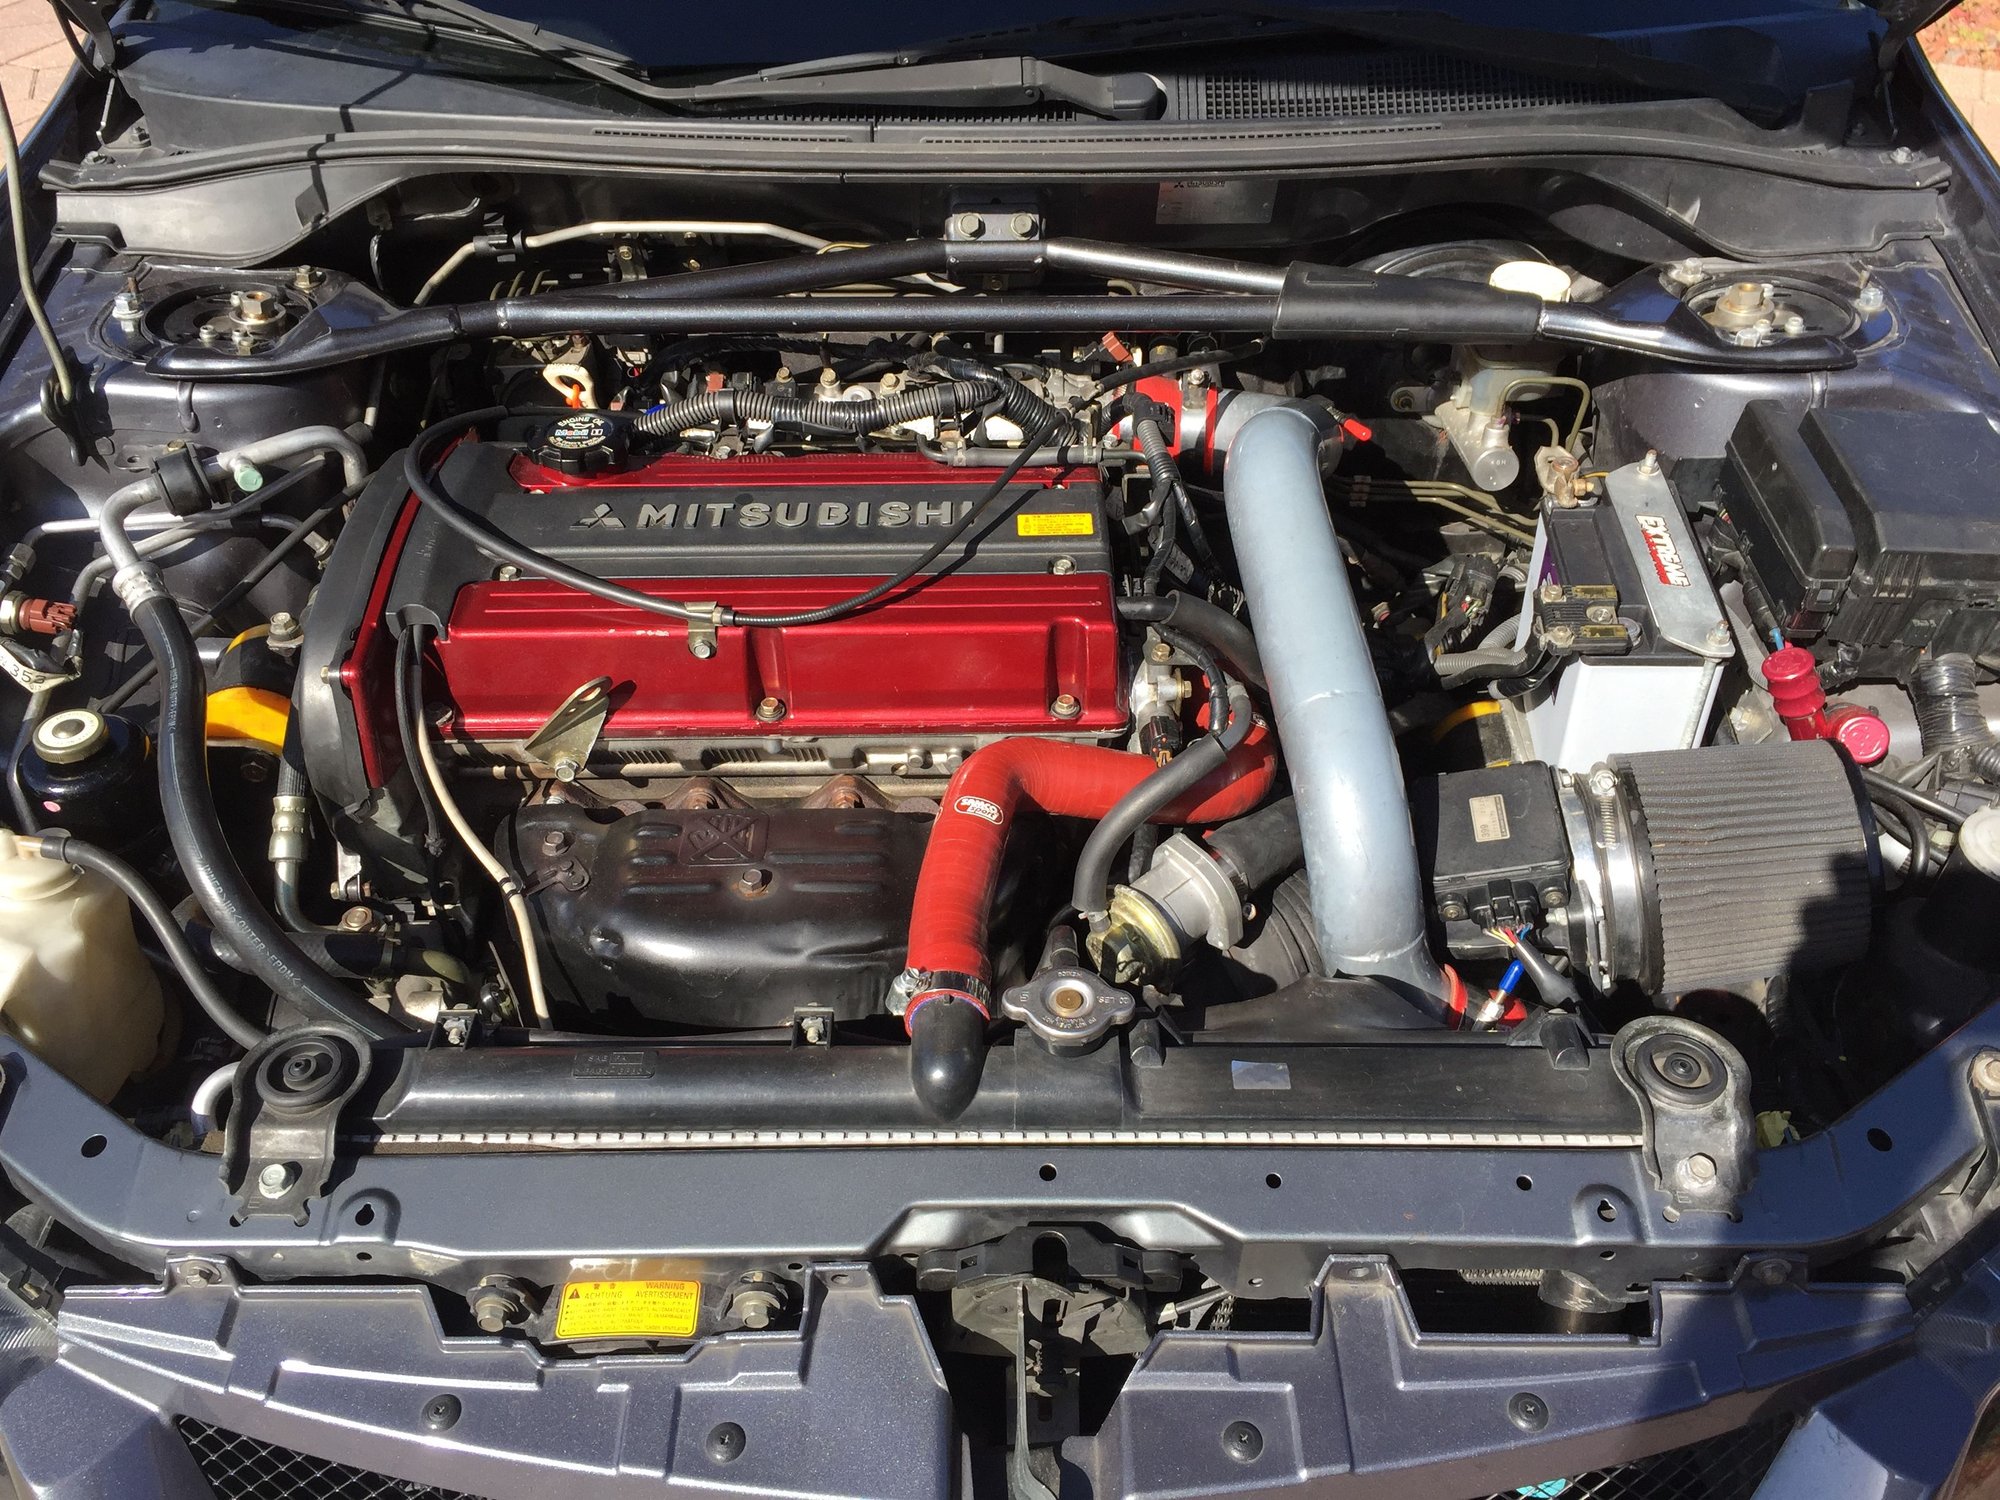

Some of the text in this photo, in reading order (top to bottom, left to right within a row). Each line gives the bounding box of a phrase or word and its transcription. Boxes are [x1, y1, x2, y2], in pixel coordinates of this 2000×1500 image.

[558, 416, 591, 427] ENGINE
[635, 501, 978, 529] MITSUBISHI
[1635, 514, 1692, 588] EXTREME
[645, 1281, 686, 1291] WARNING
[584, 1290, 623, 1300] ACHTUNG
[635, 1290, 694, 1300] AVERTISSEMENT
